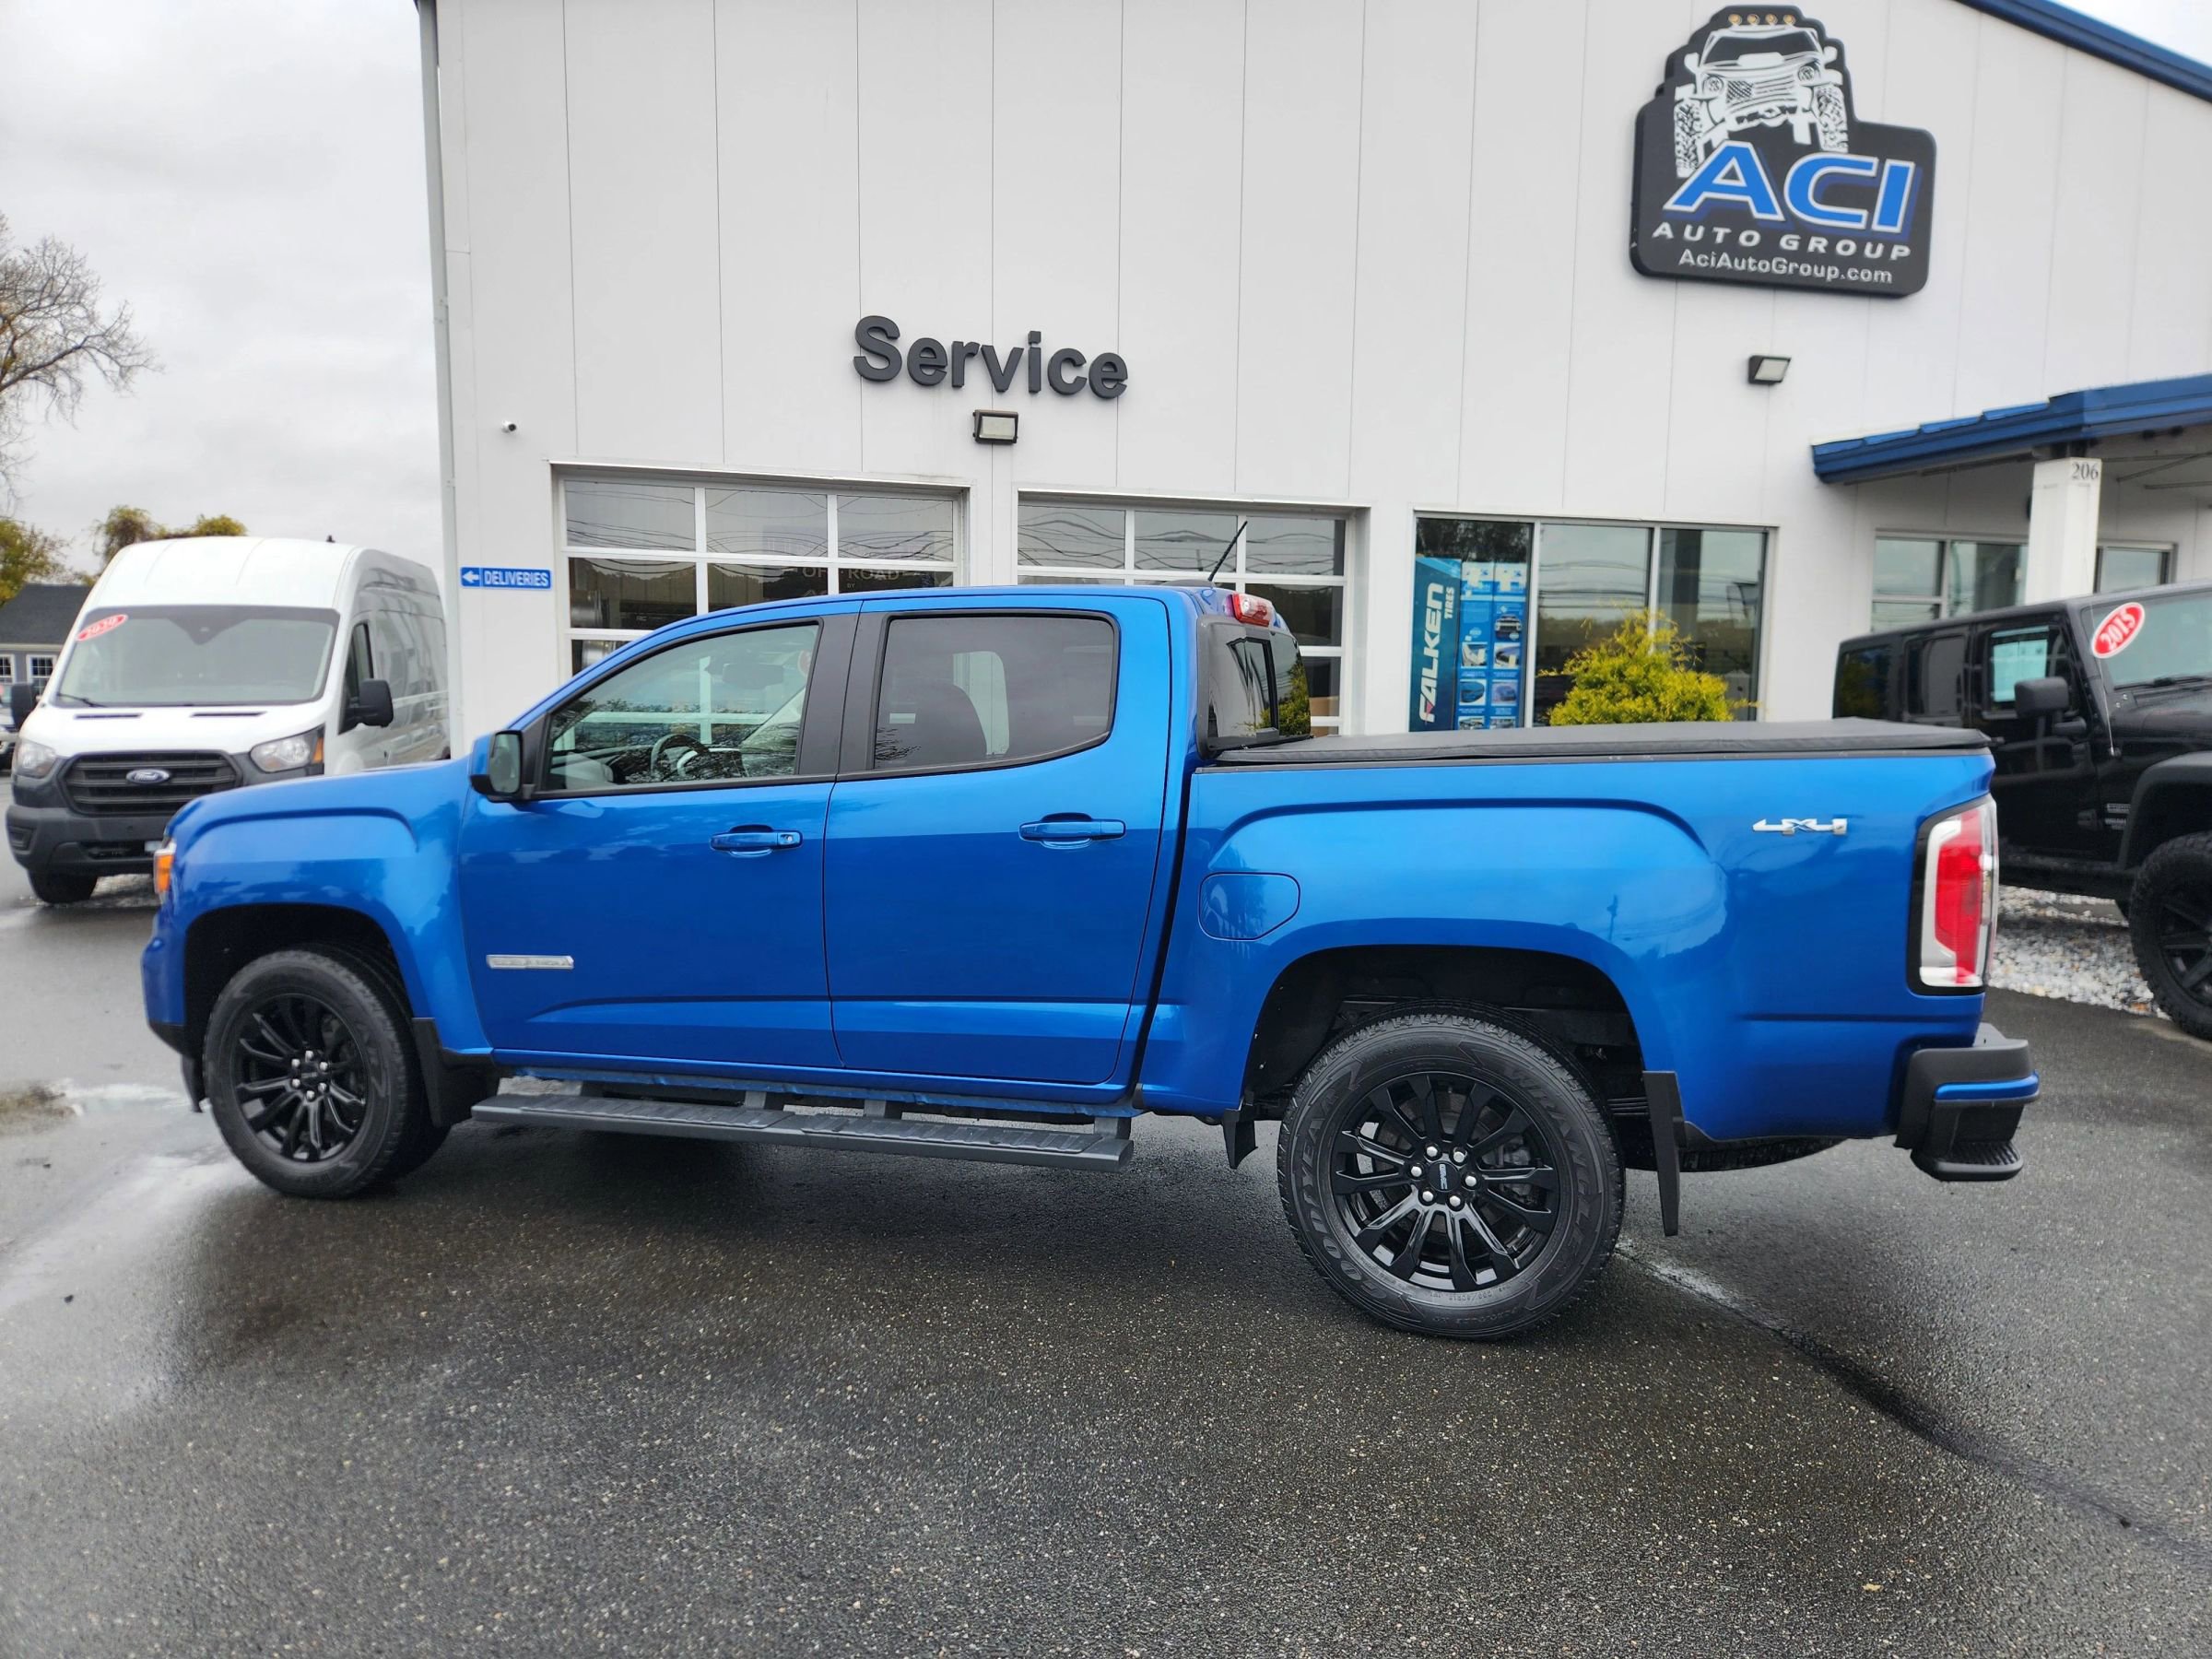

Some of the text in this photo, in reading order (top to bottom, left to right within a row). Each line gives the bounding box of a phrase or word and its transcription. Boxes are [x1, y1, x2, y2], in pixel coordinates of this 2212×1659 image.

[1663, 139, 1915, 232] ACI
[1652, 221, 1912, 262] AUTO GROUP
[1677, 248, 1893, 285] AciAutoGroup.com
[853, 315, 1128, 399] Service
[2071, 462, 2099, 480] 206
[484, 570, 548, 587] DELIVERIES
[1444, 586, 1454, 619] TIRES
[2099, 607, 2136, 651] 2015
[1419, 582, 1444, 724] FALKEN
